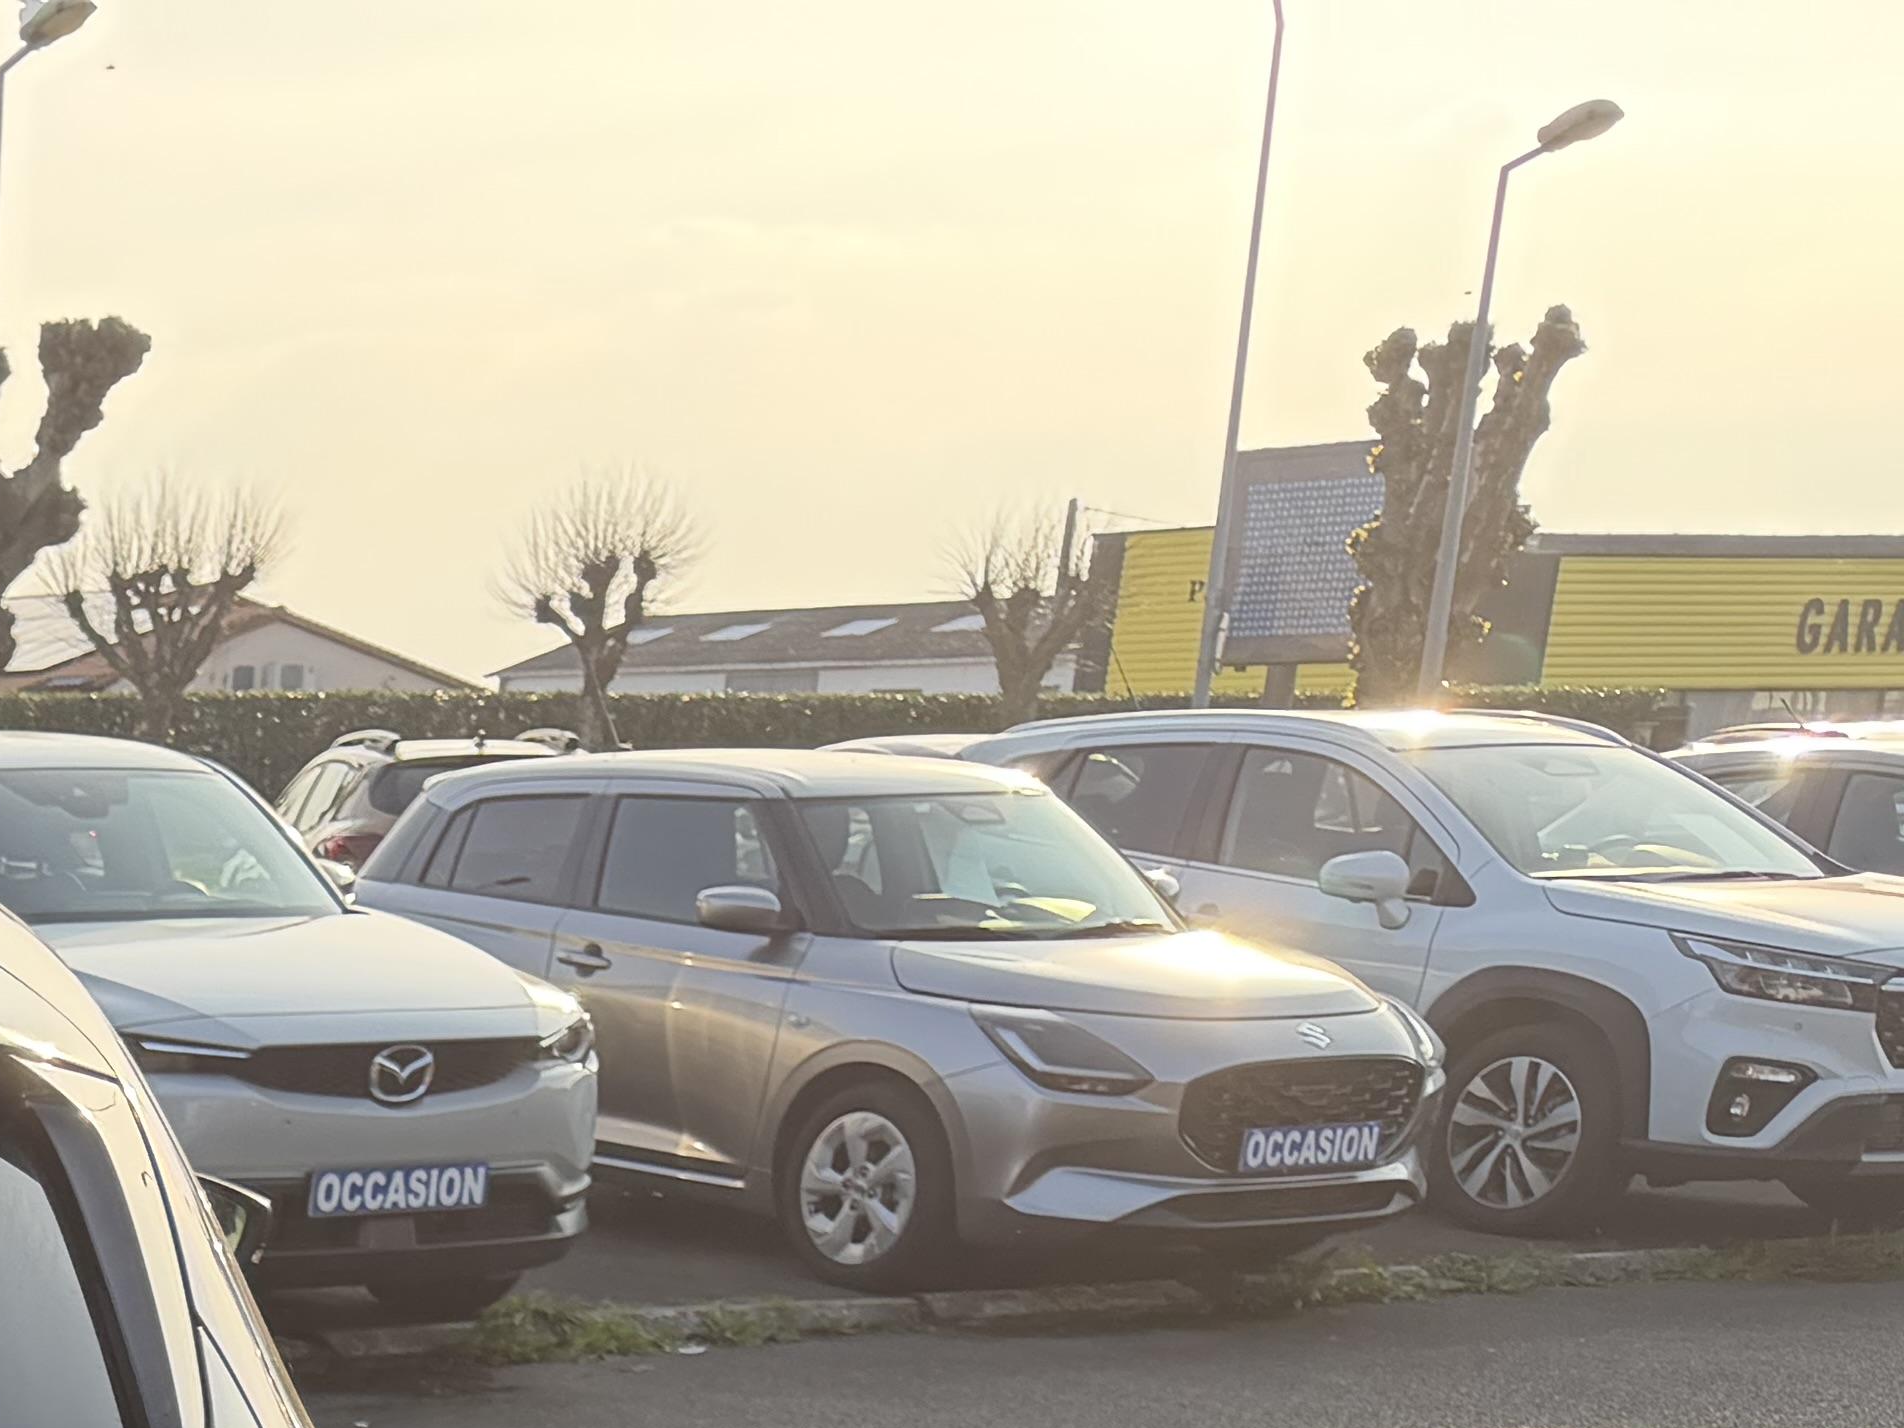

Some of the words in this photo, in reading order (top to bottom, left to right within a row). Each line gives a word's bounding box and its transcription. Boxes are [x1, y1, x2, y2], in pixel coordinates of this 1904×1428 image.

[1796, 597, 1904, 656] GARA
[1246, 1126, 1379, 1168] OCCASION
[317, 1167, 485, 1212] OCCASION
